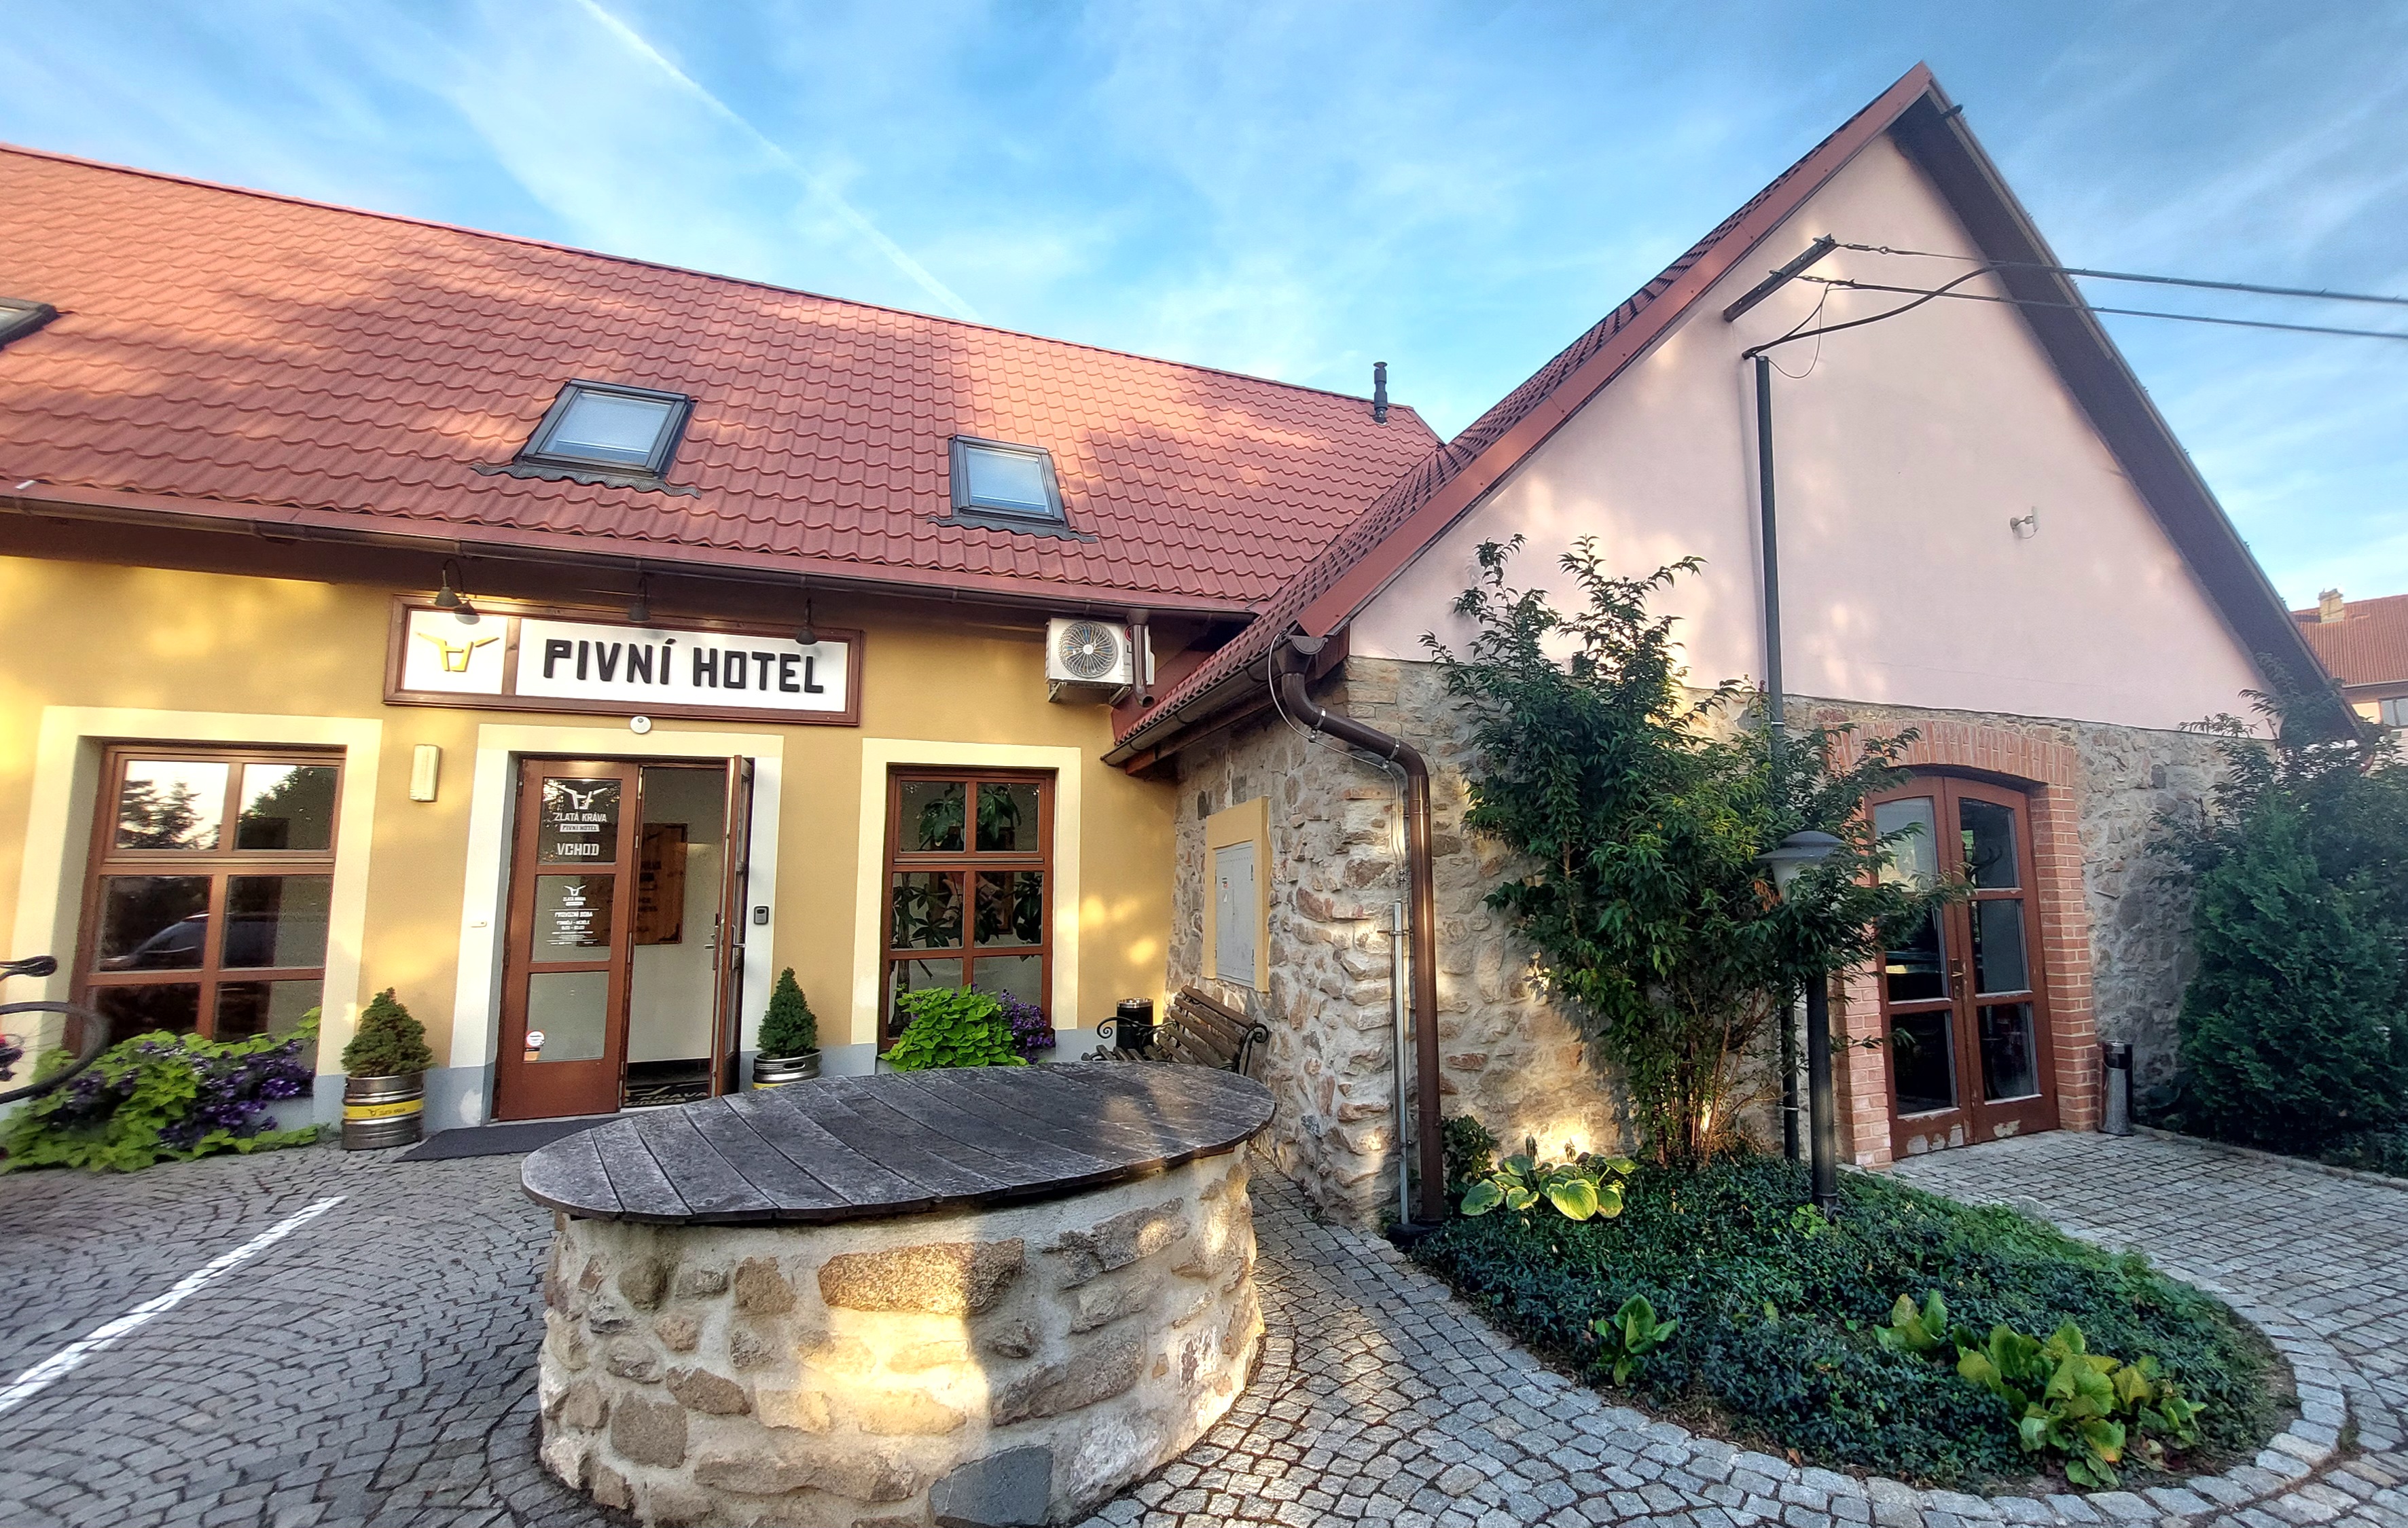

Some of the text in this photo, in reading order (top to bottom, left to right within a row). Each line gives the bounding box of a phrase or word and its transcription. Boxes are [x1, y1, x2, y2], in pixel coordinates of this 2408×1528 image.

[543, 638, 824, 693] PIVNÍ HOTEL
[553, 812, 607, 822] ZLATÁ KRÁVA
[557, 843, 599, 856] VCHOD
